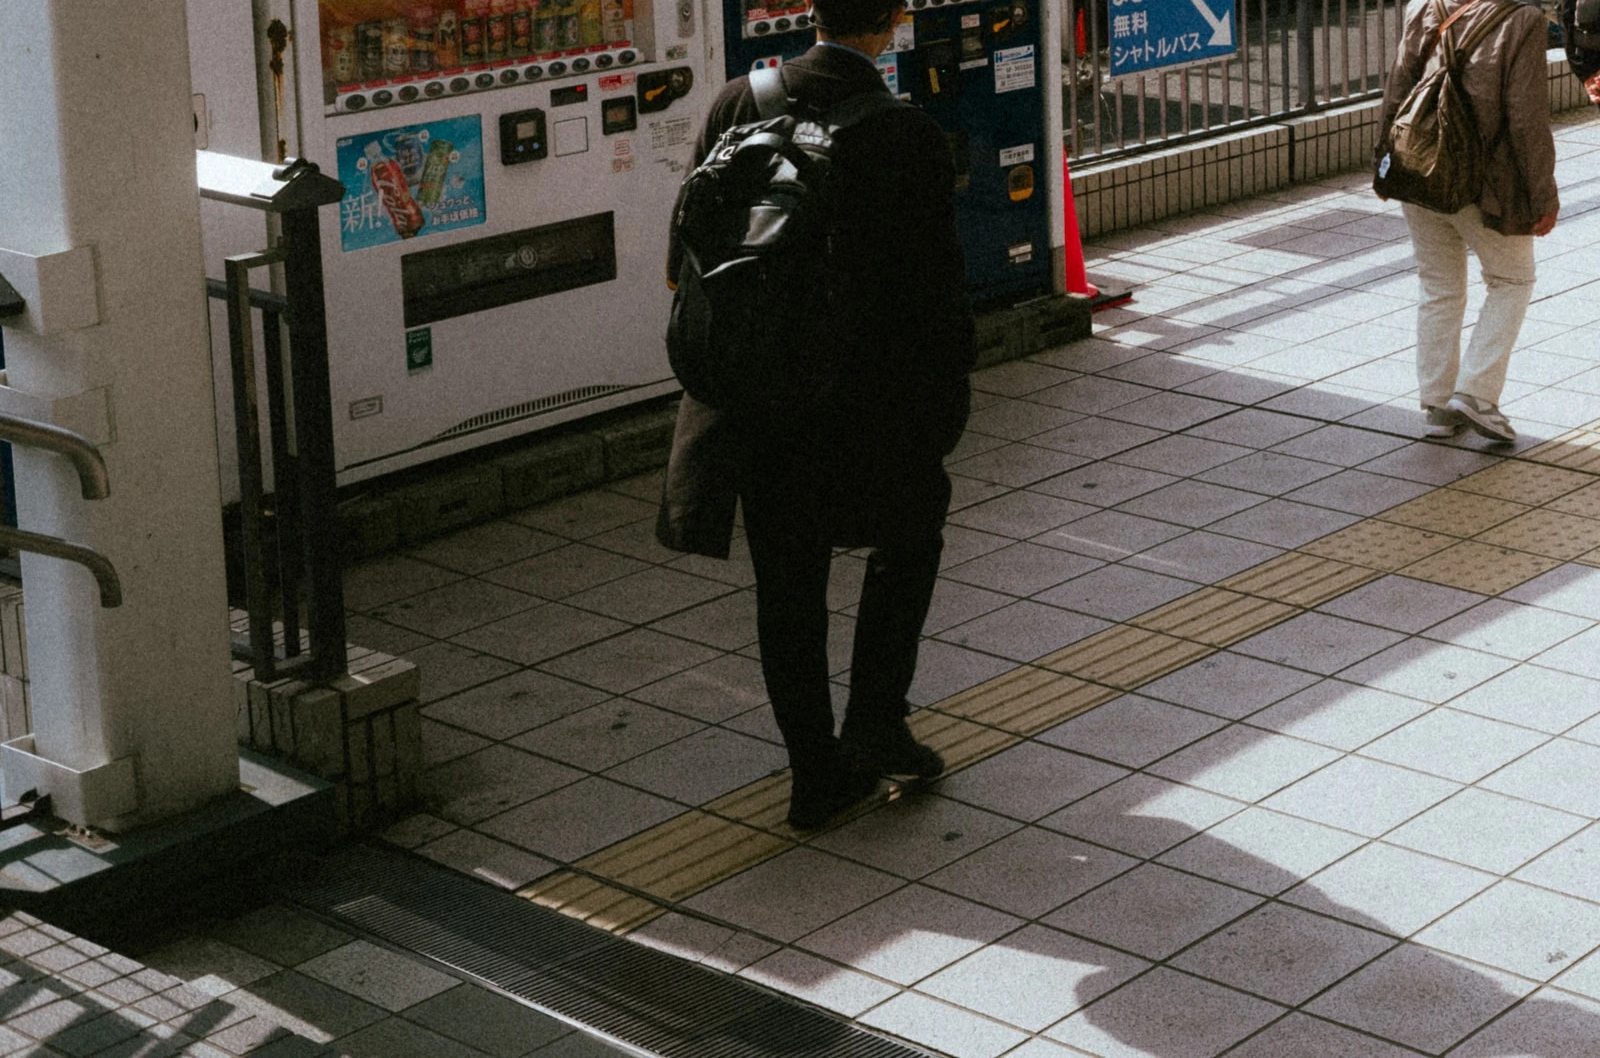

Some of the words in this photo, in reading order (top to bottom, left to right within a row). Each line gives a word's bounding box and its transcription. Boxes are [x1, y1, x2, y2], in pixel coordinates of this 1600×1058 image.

[1113, 11, 1148, 38] 無料
[1114, 32, 1202, 67] シャトルバス
